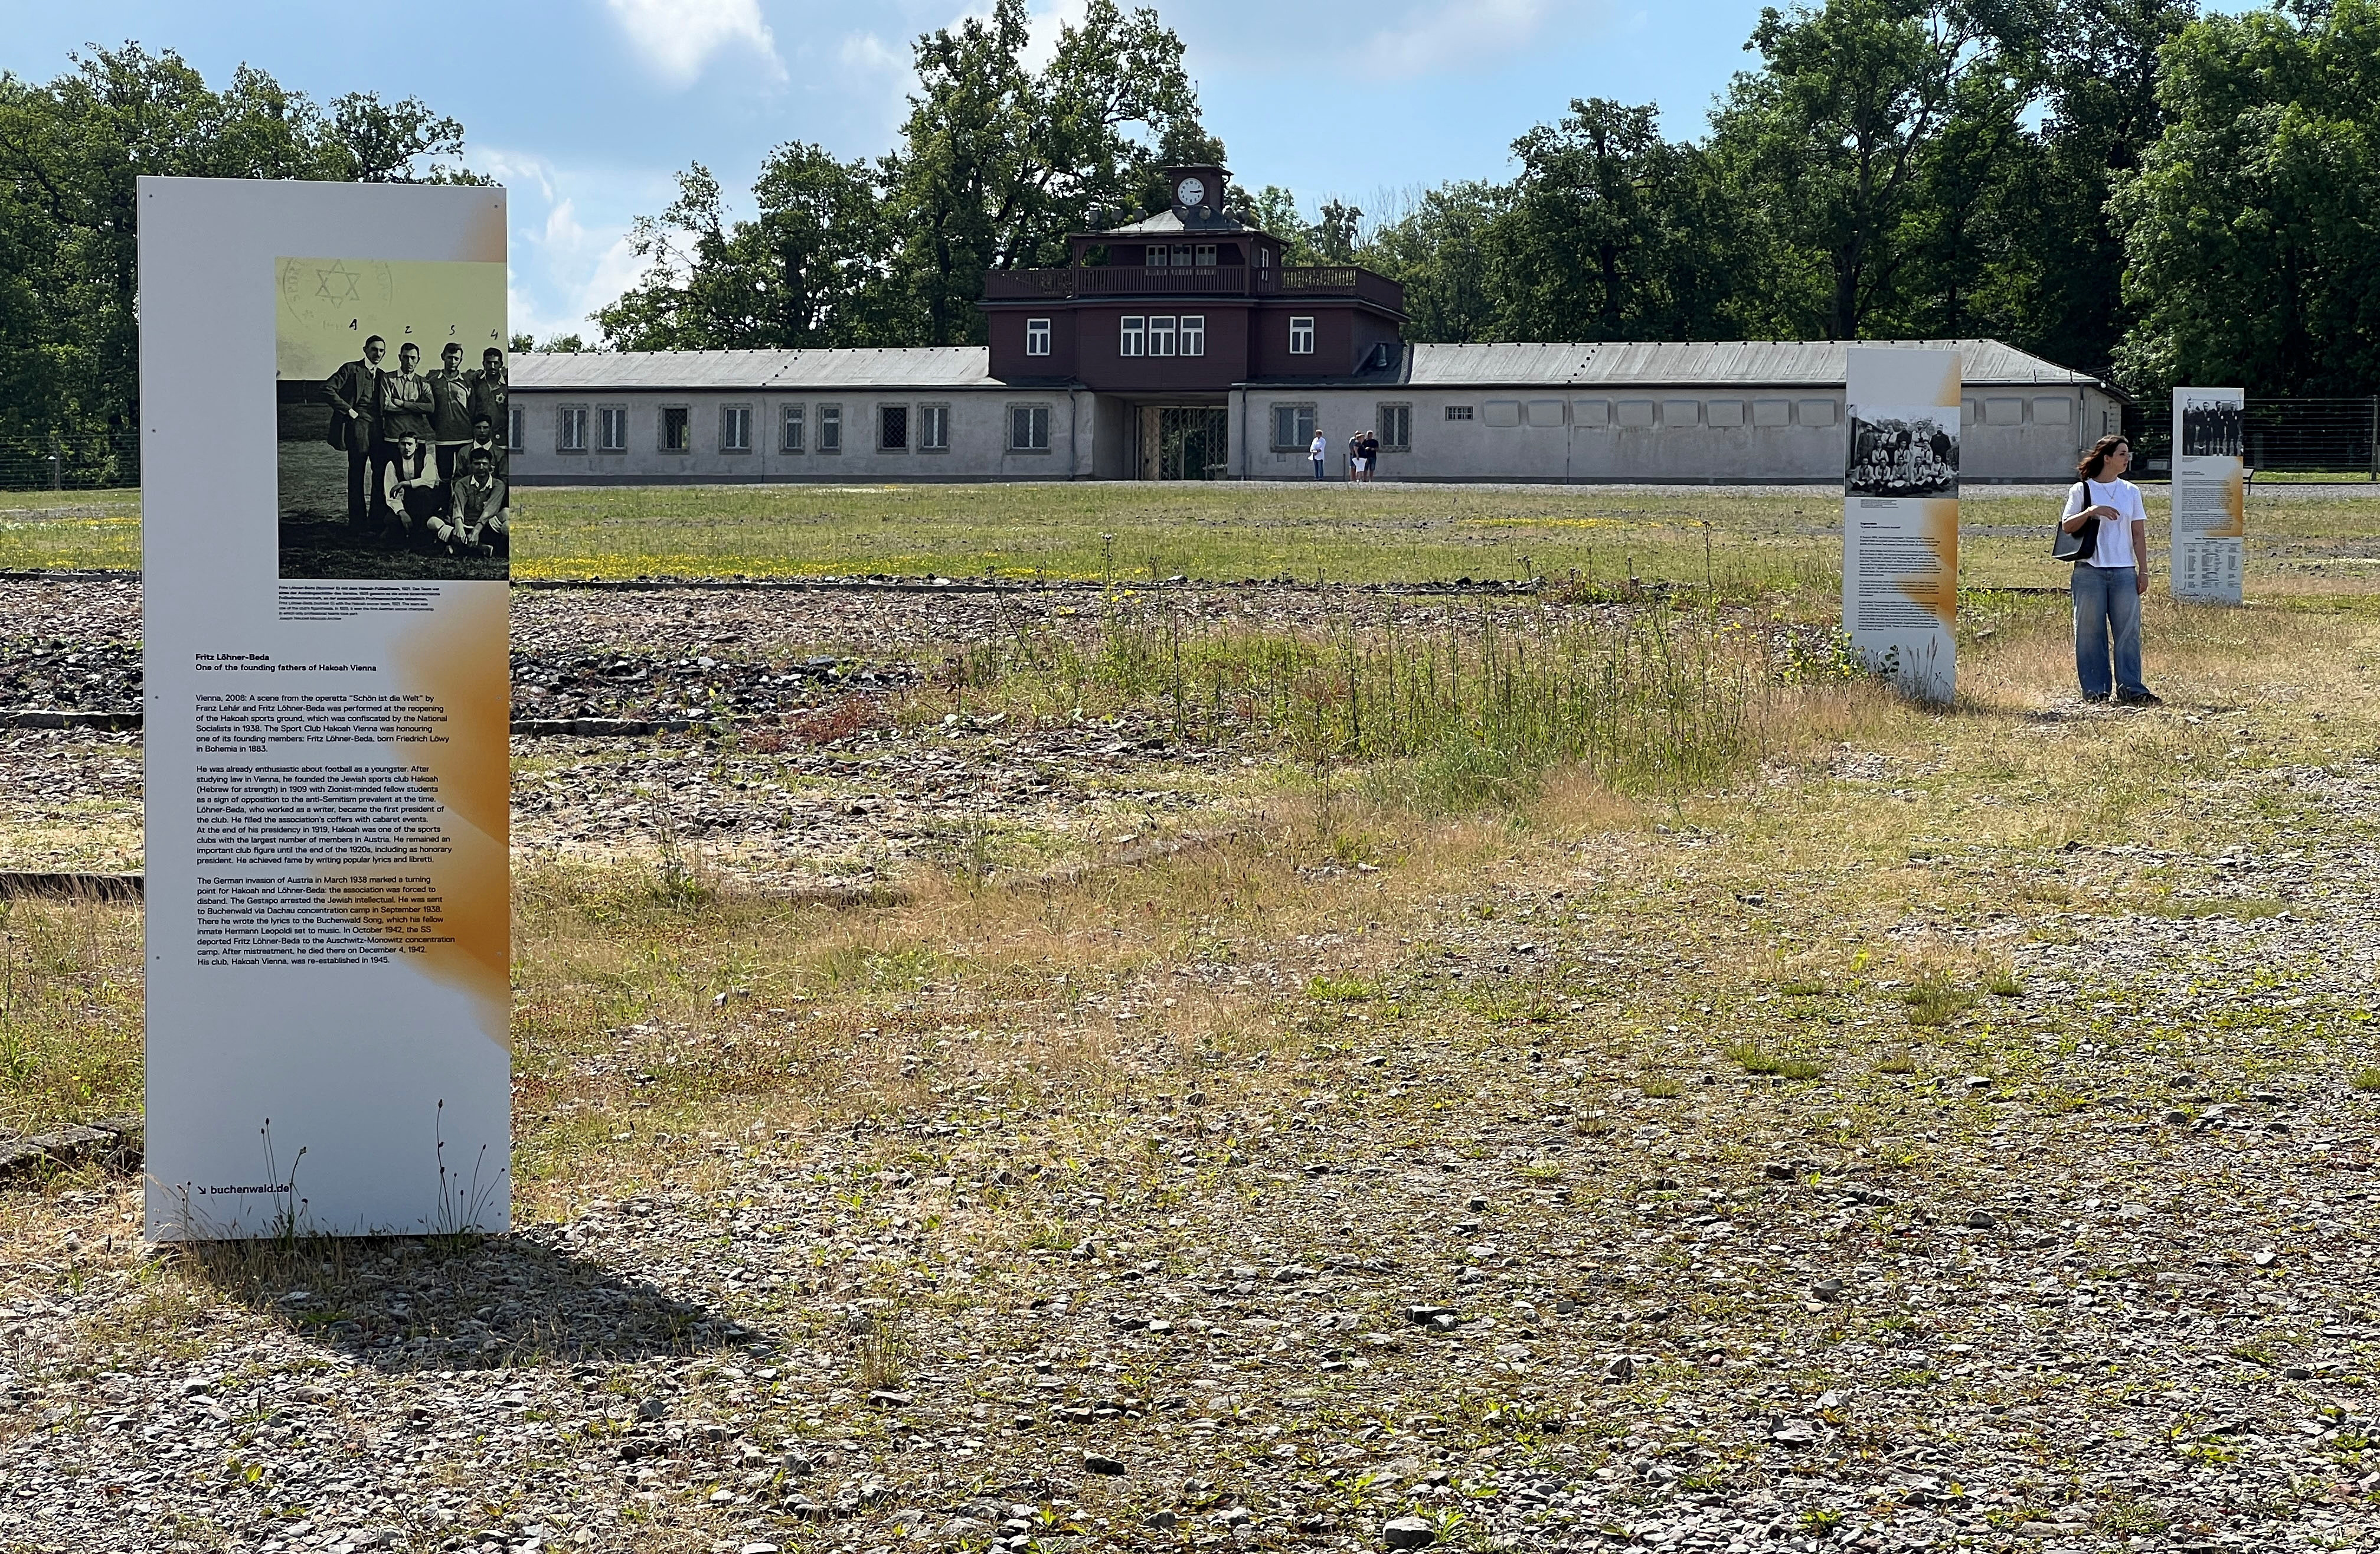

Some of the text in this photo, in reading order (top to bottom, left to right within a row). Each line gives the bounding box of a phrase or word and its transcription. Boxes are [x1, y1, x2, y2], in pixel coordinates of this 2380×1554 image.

[405, 325, 412, 334] 2
[491, 329, 498, 340] 4
[240, 664, 276, 673] founding
[315, 695, 347, 703] operetta
[425, 695, 434, 703] by
[195, 704, 217, 712] Franz
[343, 704, 382, 713] performed
[407, 705, 444, 714] reopening
[276, 714, 305, 724] ground,
[392, 714, 401, 723] by
[280, 724, 302, 734] Sport
[395, 724, 433, 733] honouring
[233, 735, 266, 744] founding
[325, 734, 375, 743] Löhner-Beda,
[430, 735, 450, 743] Löwy
[225, 765, 253, 774] already
[196, 775, 228, 785] studying
[253, 775, 281, 783] Vienna,
[294, 775, 325, 783] founded
[197, 785, 229, 795] (Hebrew
[244, 786, 279, 795] strength)
[405, 876, 431, 884] turning
[197, 888, 216, 896] point
[277, 886, 327, 894] Löhner-Beda:
[246, 897, 279, 906] Gestapo
[380, 906, 421, 915] September
[210, 1184, 289, 1194] buchenwald.de
